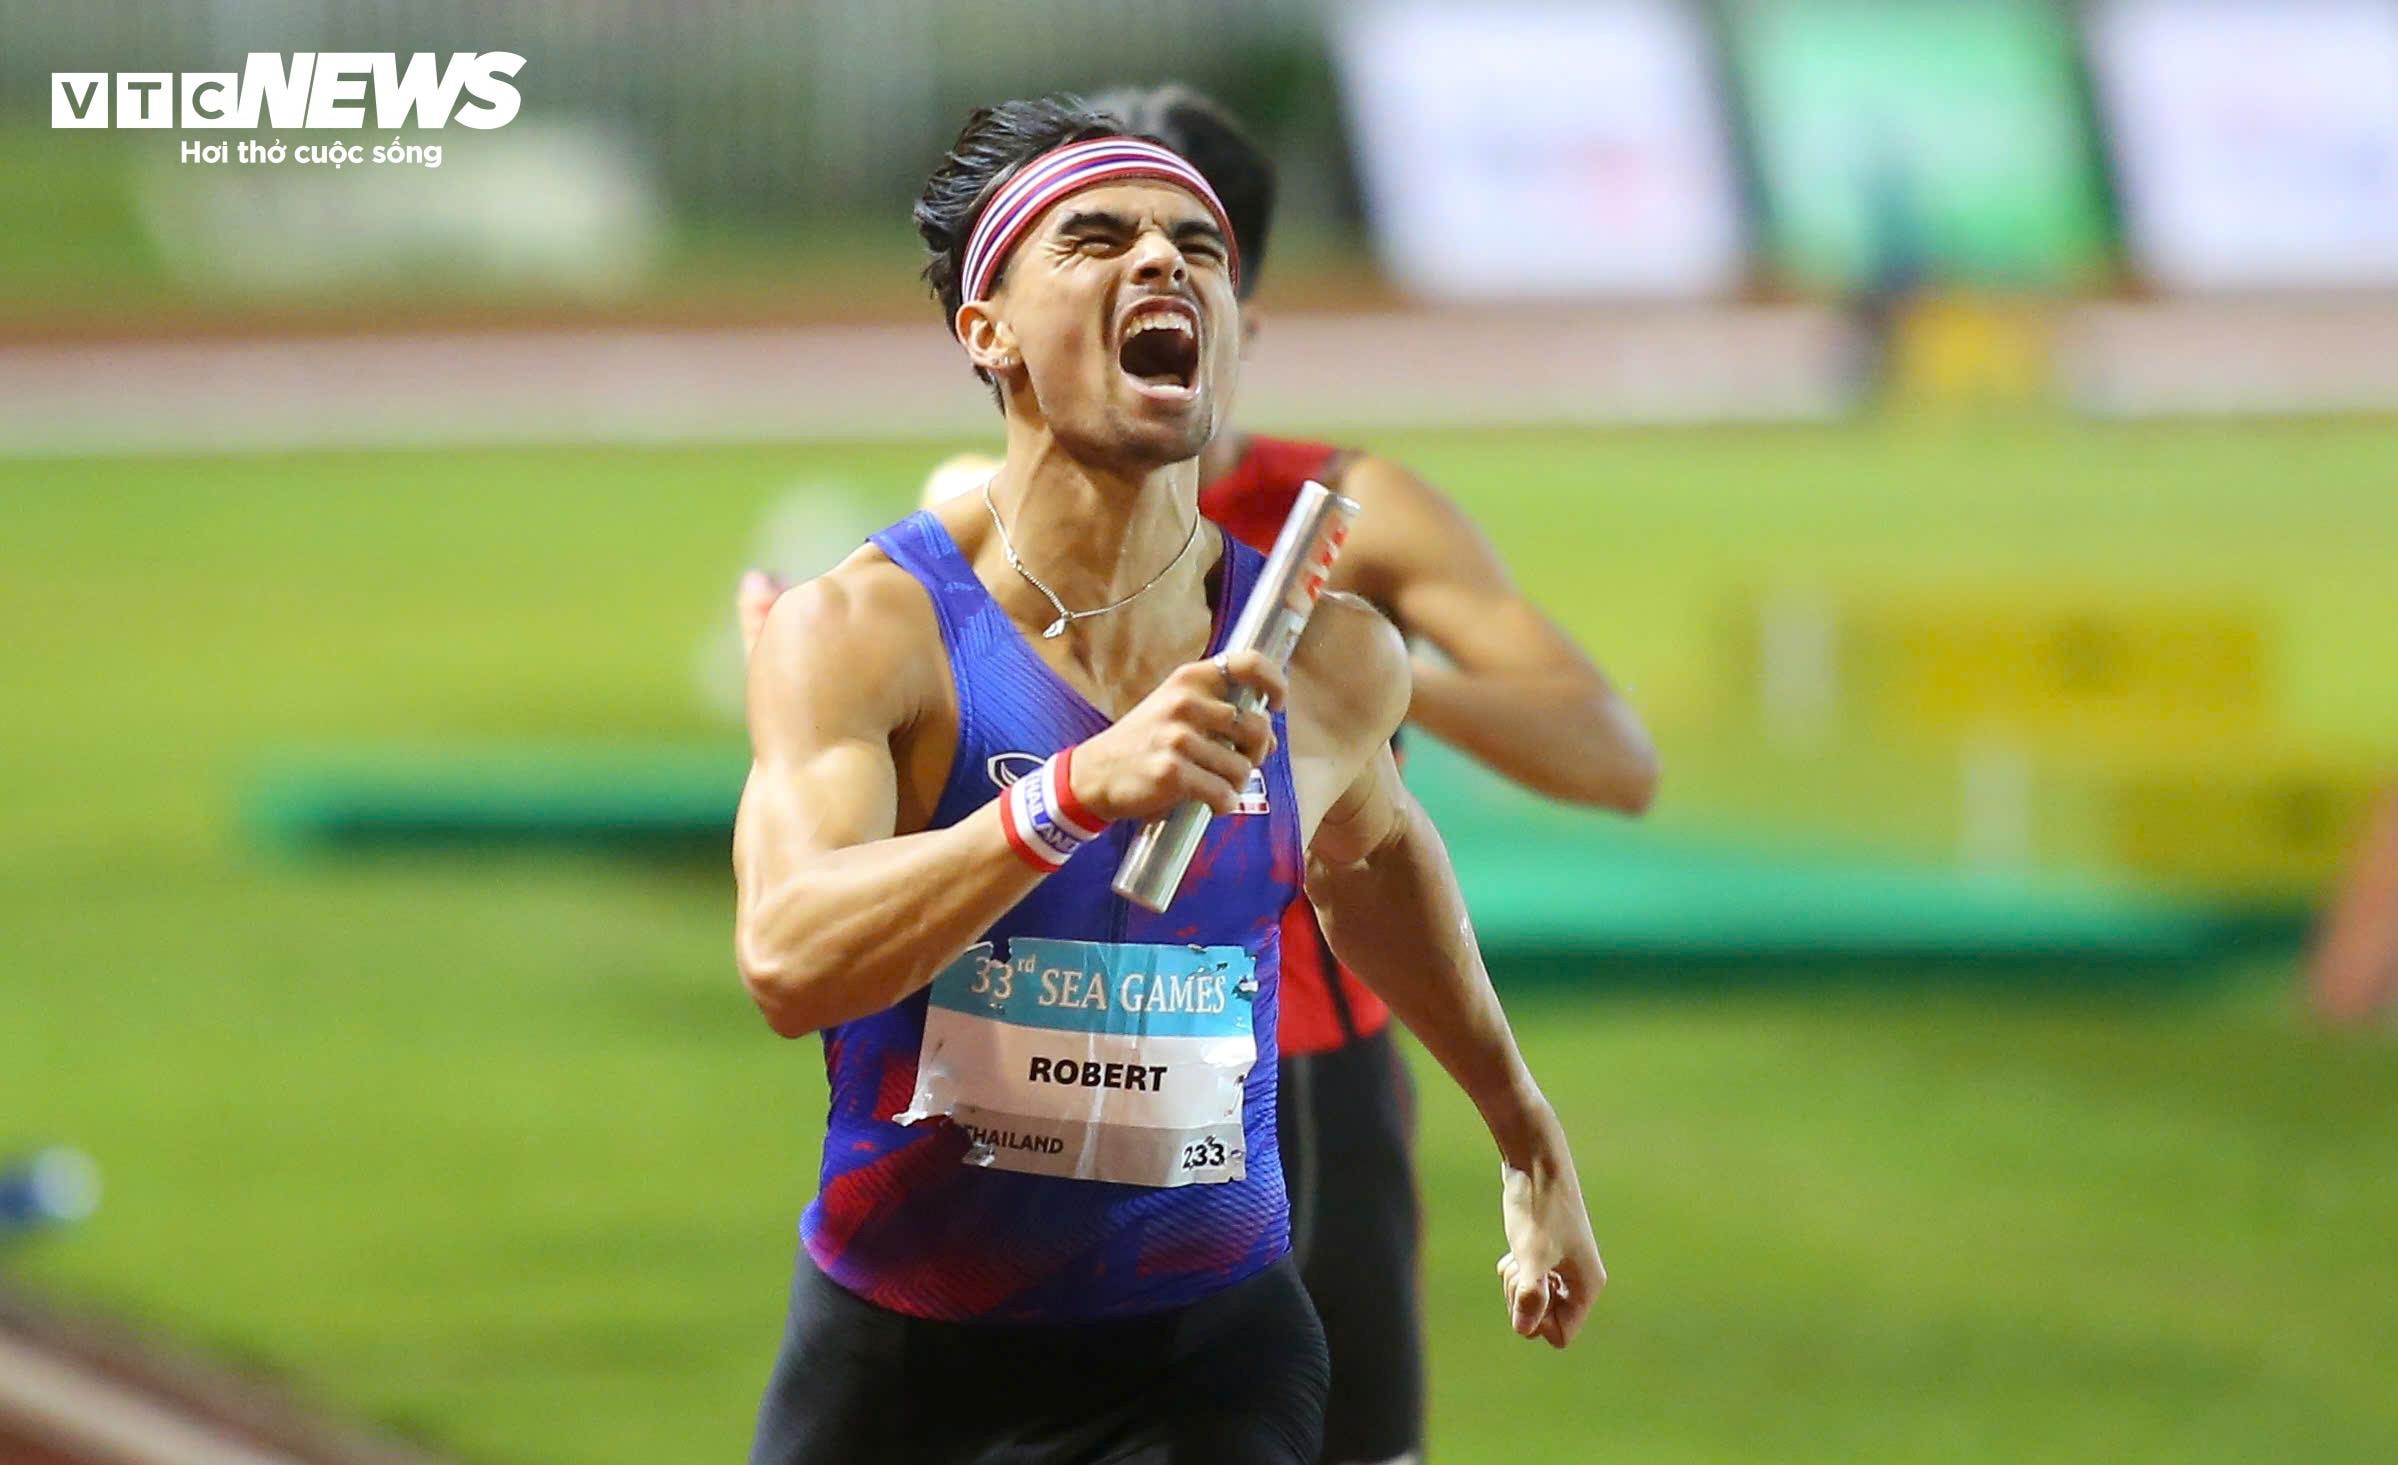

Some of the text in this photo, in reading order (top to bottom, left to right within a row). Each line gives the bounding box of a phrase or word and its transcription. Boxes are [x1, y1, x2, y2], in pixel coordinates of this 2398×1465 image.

[1038, 968, 1107, 1011] SEA
[1120, 973, 1227, 1014] GAMES
[1029, 1057, 1168, 1092] ROBERT
[1182, 1142, 1225, 1170] 233
